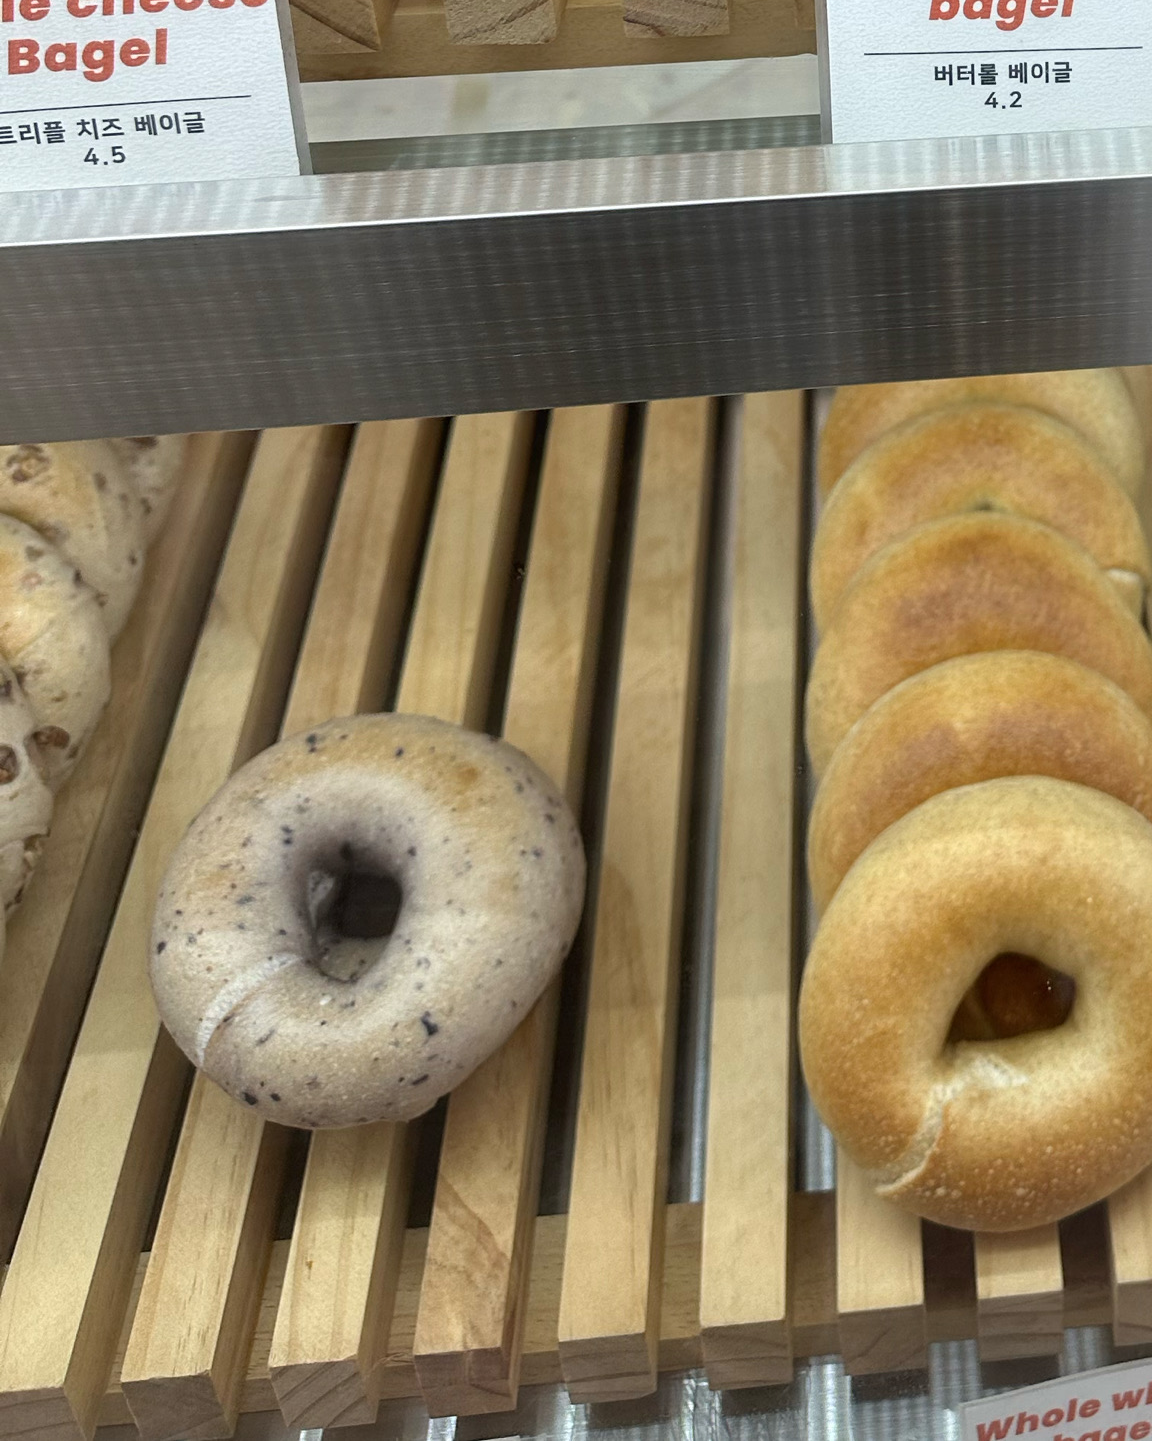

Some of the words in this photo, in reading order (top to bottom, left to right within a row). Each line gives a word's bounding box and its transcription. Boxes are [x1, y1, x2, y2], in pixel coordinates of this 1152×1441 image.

[8, 28, 167, 82] Bagel
[935, 64, 998, 86] 버터롤
[1009, 62, 1072, 84] 베이글
[985, 91, 1022, 109] 4.2
[0, 121, 65, 144] 트리플
[77, 119, 124, 140] 치즈
[134, 112, 205, 135] 베이글
[84, 146, 125, 165] 4.5
[977, 1398, 1102, 1441] Whole
